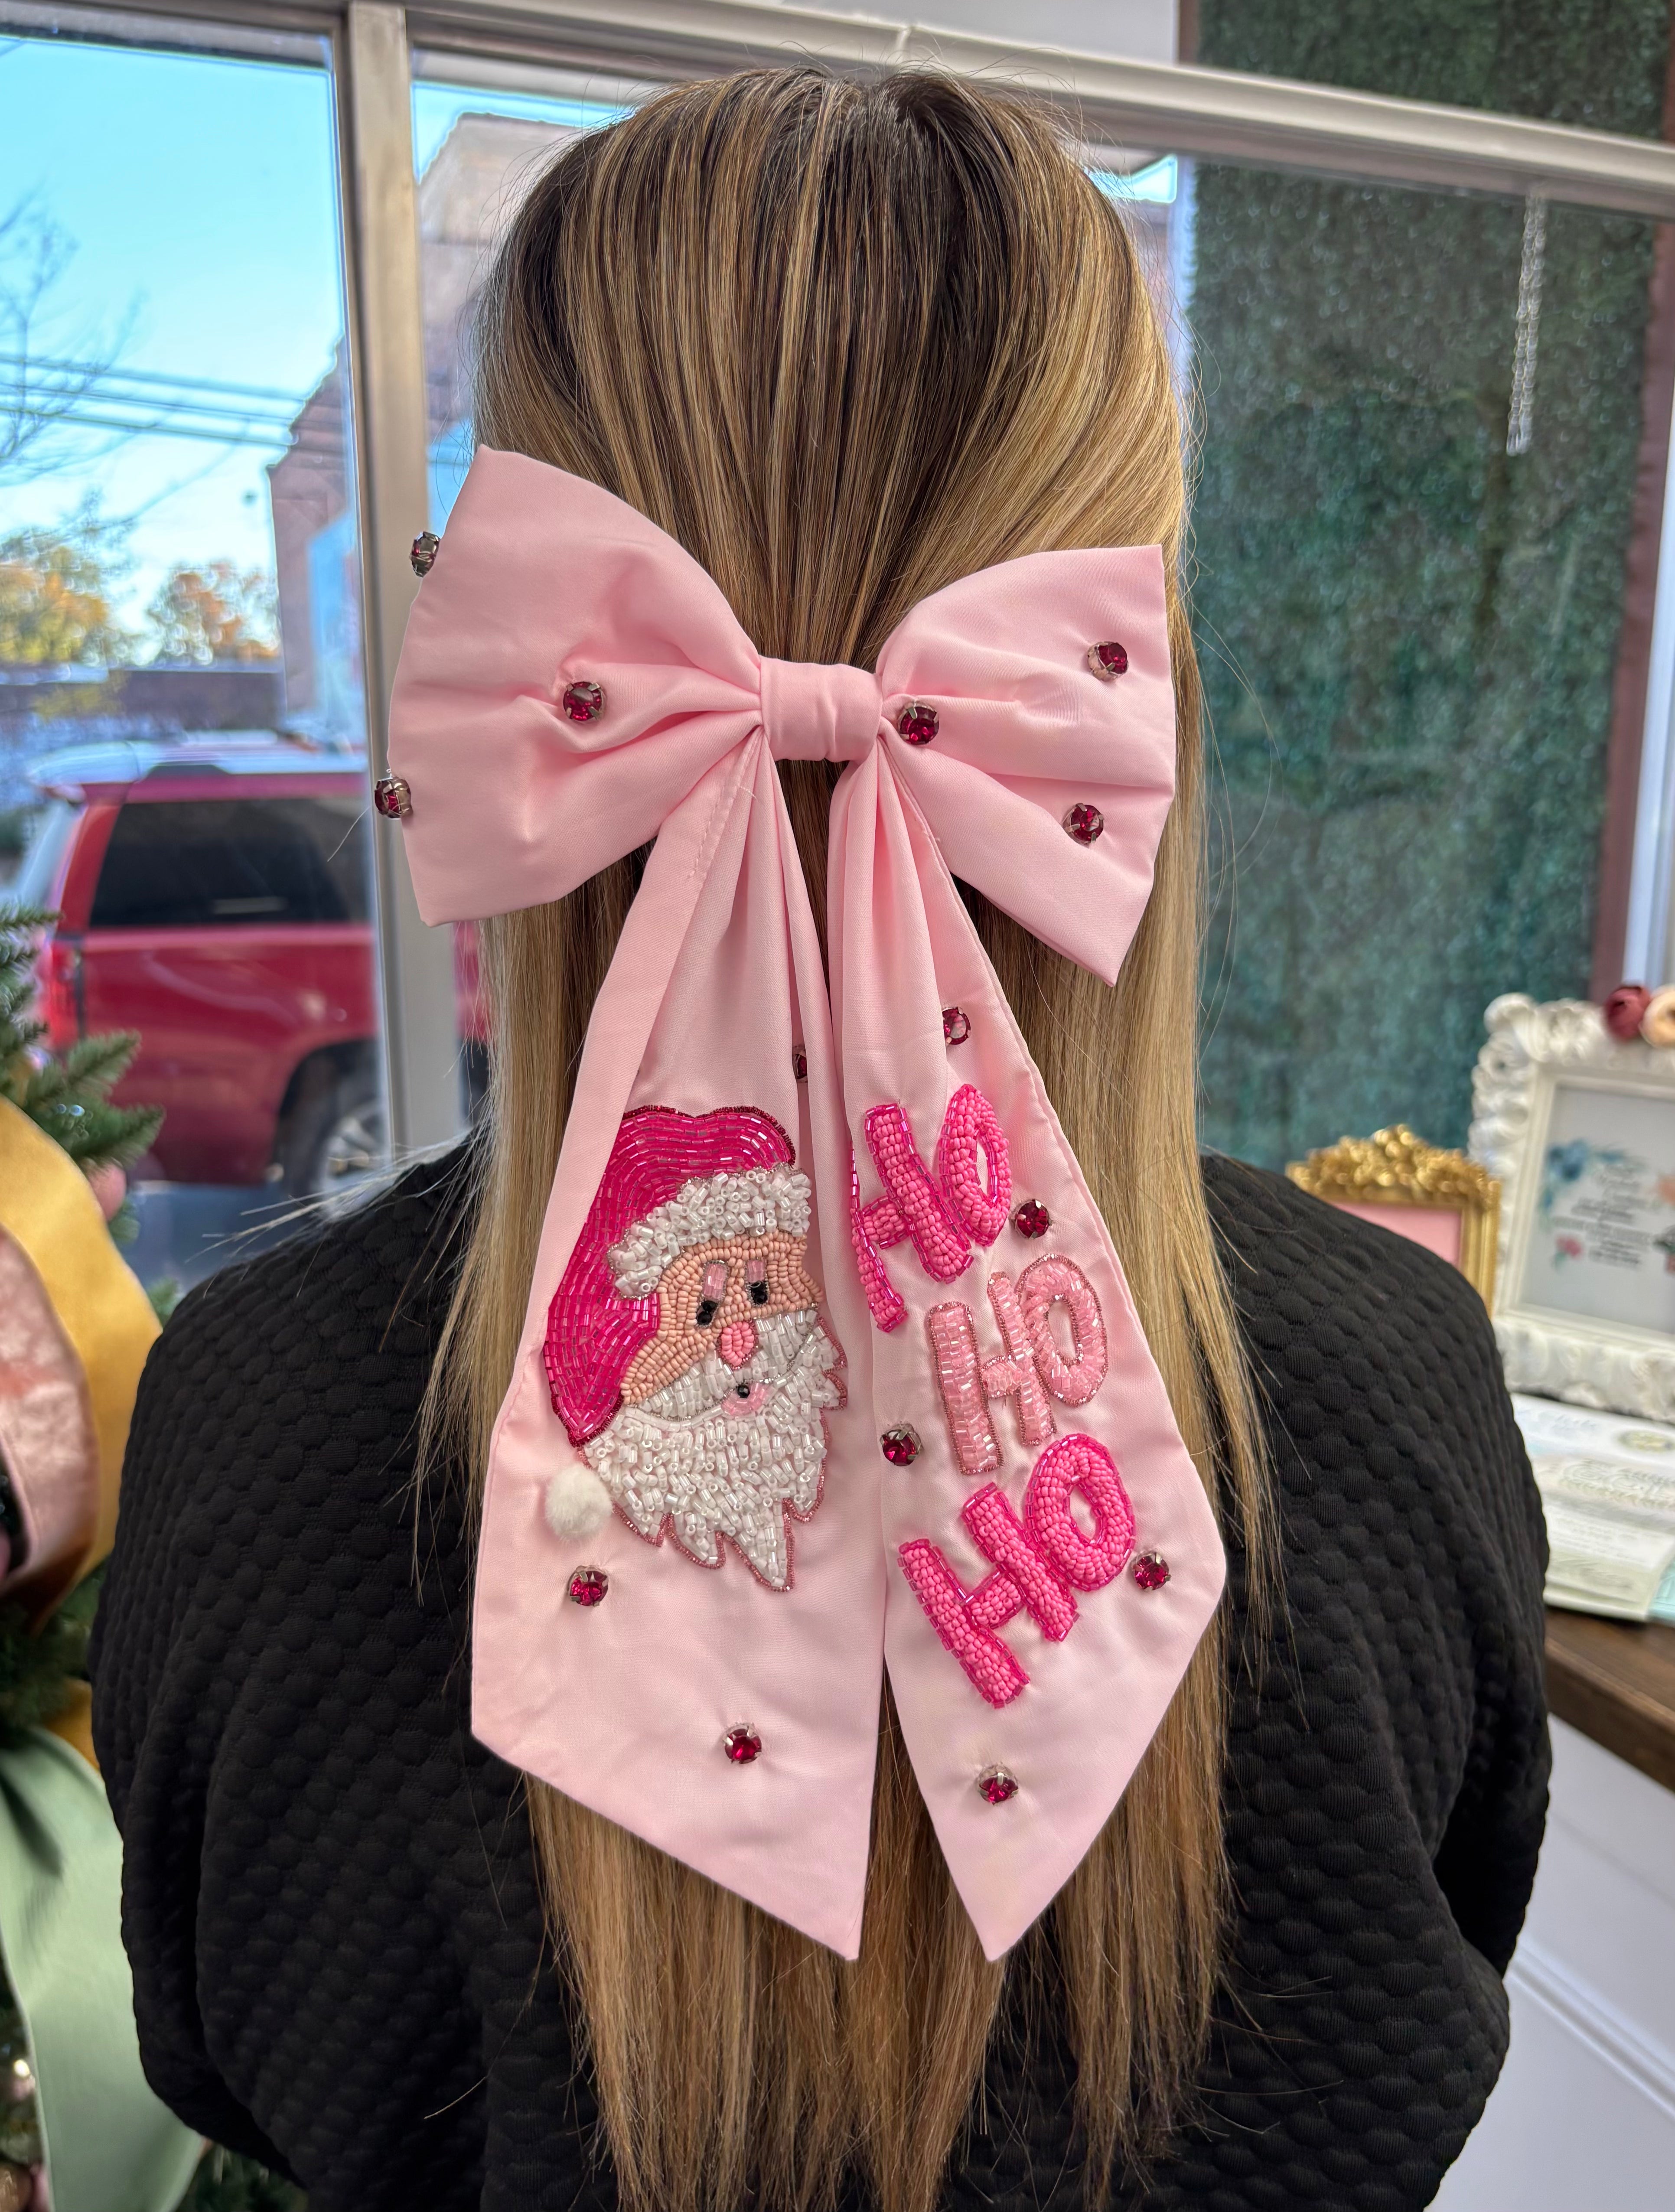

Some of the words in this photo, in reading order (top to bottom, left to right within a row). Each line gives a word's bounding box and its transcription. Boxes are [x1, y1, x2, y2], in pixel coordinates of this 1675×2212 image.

[850, 1084, 1011, 1332] HO
[928, 1253, 1109, 1475] HO
[898, 1432, 1136, 1709] HO
